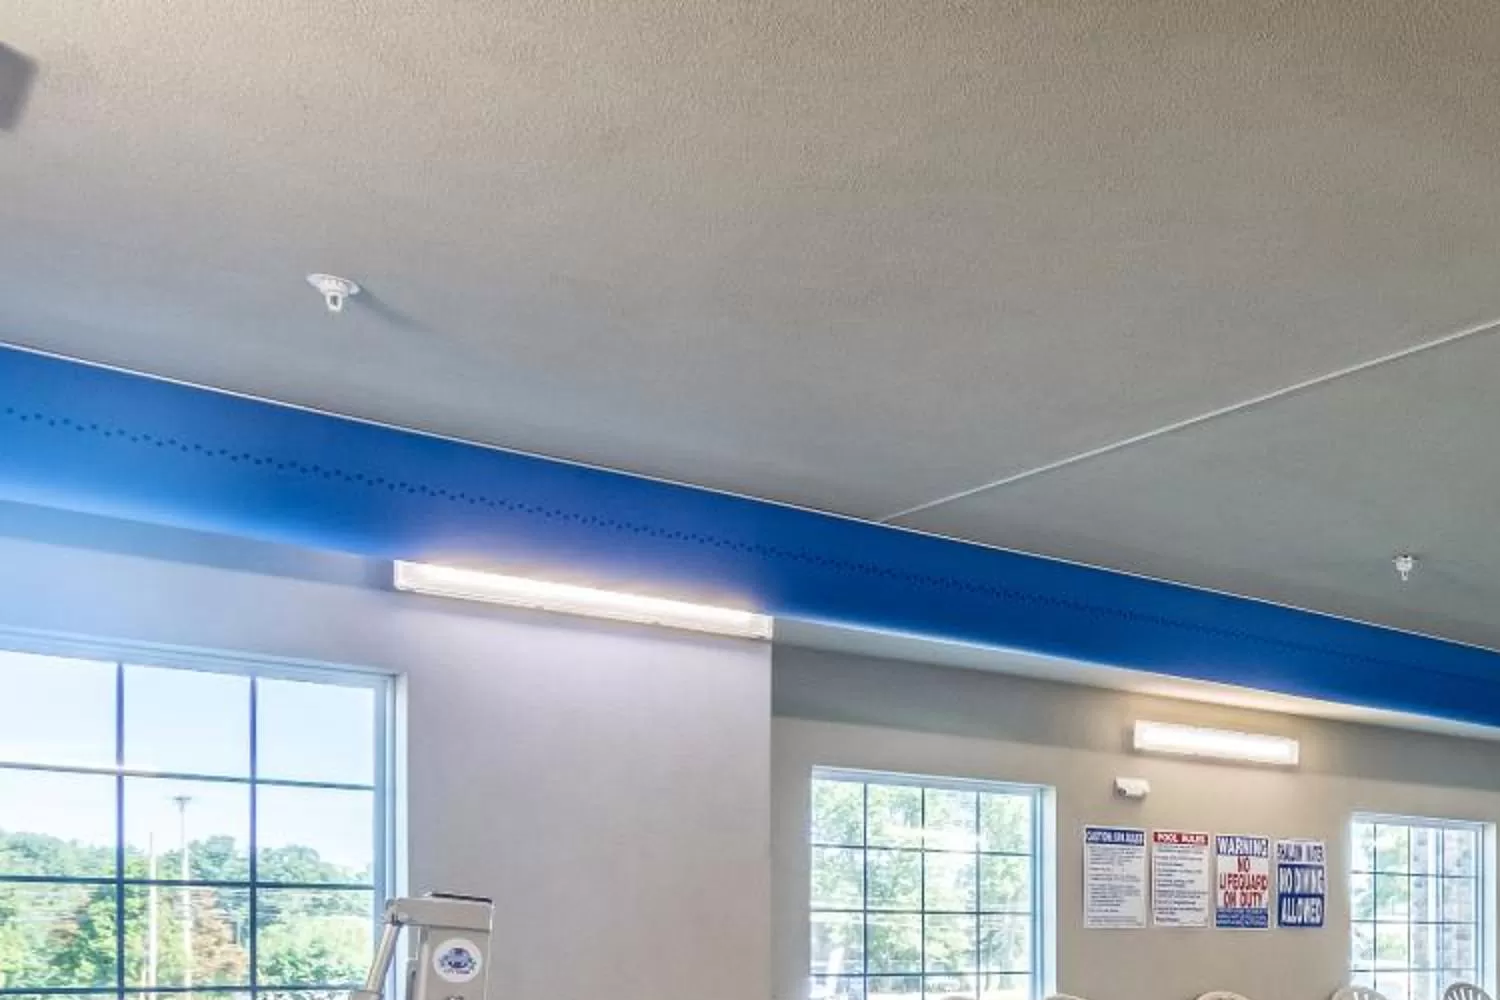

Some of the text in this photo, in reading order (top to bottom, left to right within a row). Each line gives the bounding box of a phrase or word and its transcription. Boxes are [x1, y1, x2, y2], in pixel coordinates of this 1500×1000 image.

[1217, 837, 1268, 857] WARNING
[1237, 856, 1250, 873] NO
[1219, 873, 1268, 890] LIFEGUARD
[1279, 867, 1324, 894] NO DIVING
[1223, 891, 1263, 908] ON DUTY
[1281, 897, 1322, 924] ALLOWED
